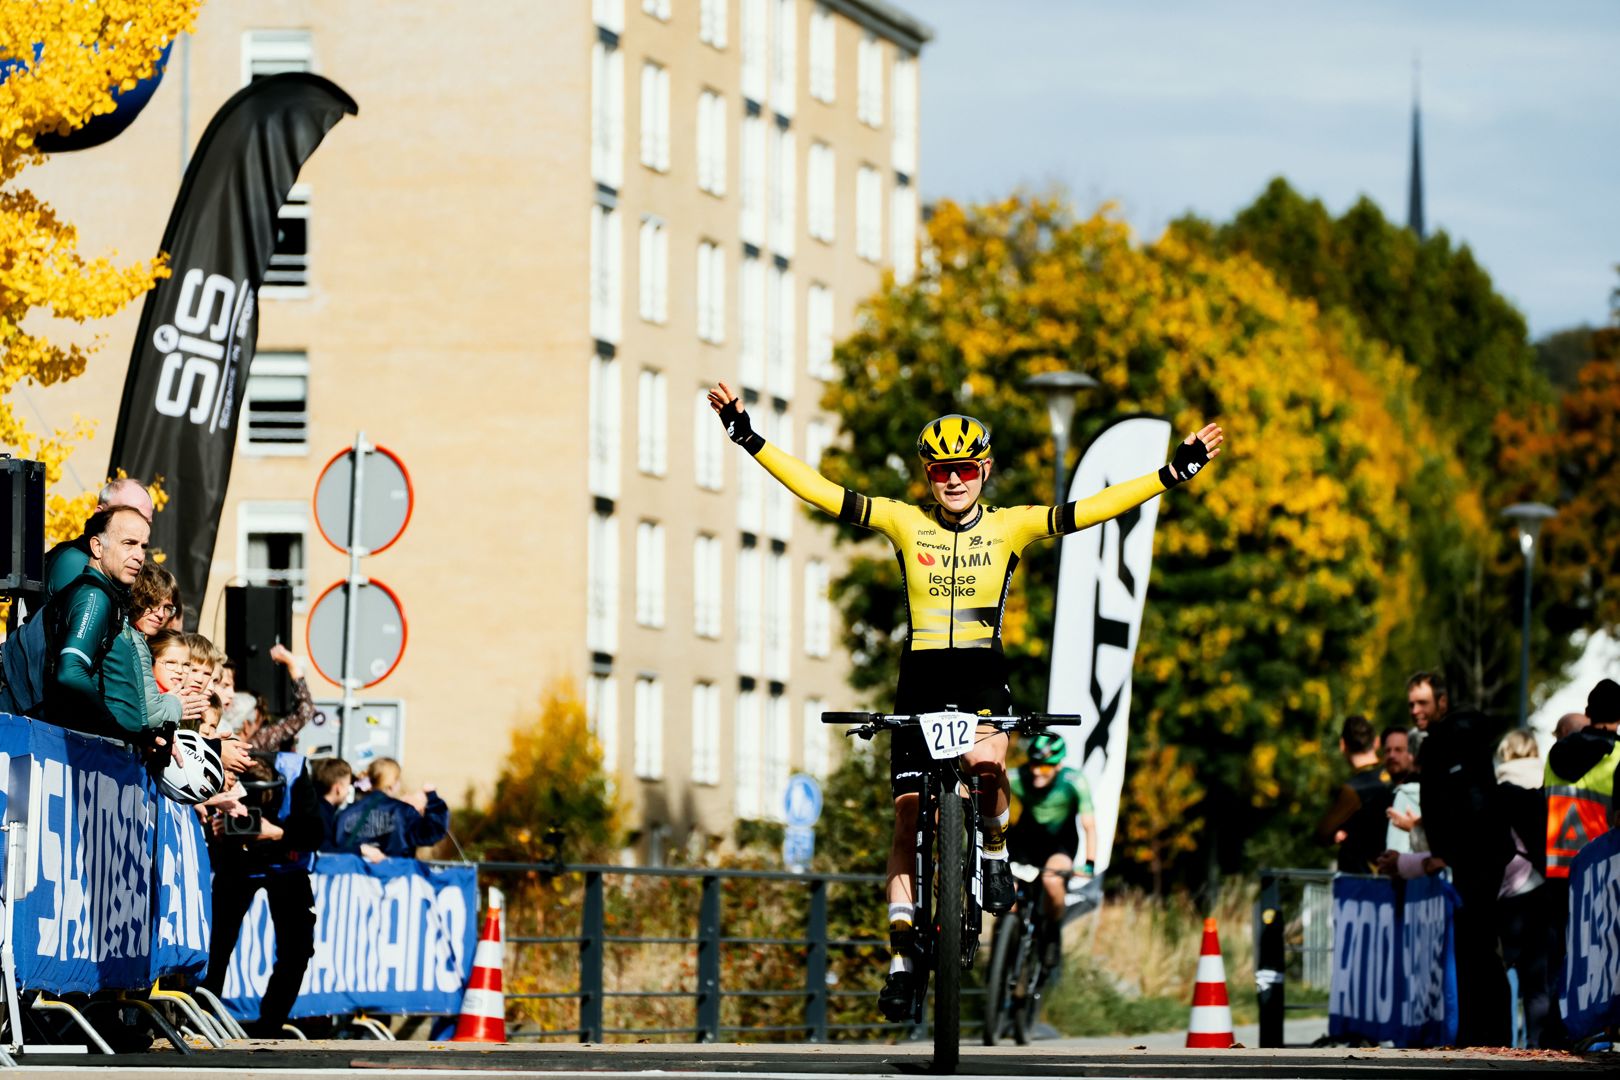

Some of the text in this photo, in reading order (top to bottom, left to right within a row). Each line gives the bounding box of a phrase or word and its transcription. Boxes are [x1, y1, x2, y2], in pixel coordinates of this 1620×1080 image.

[941, 552, 992, 569] VISMA
[928, 572, 976, 585] lease
[932, 720, 969, 751] 212
